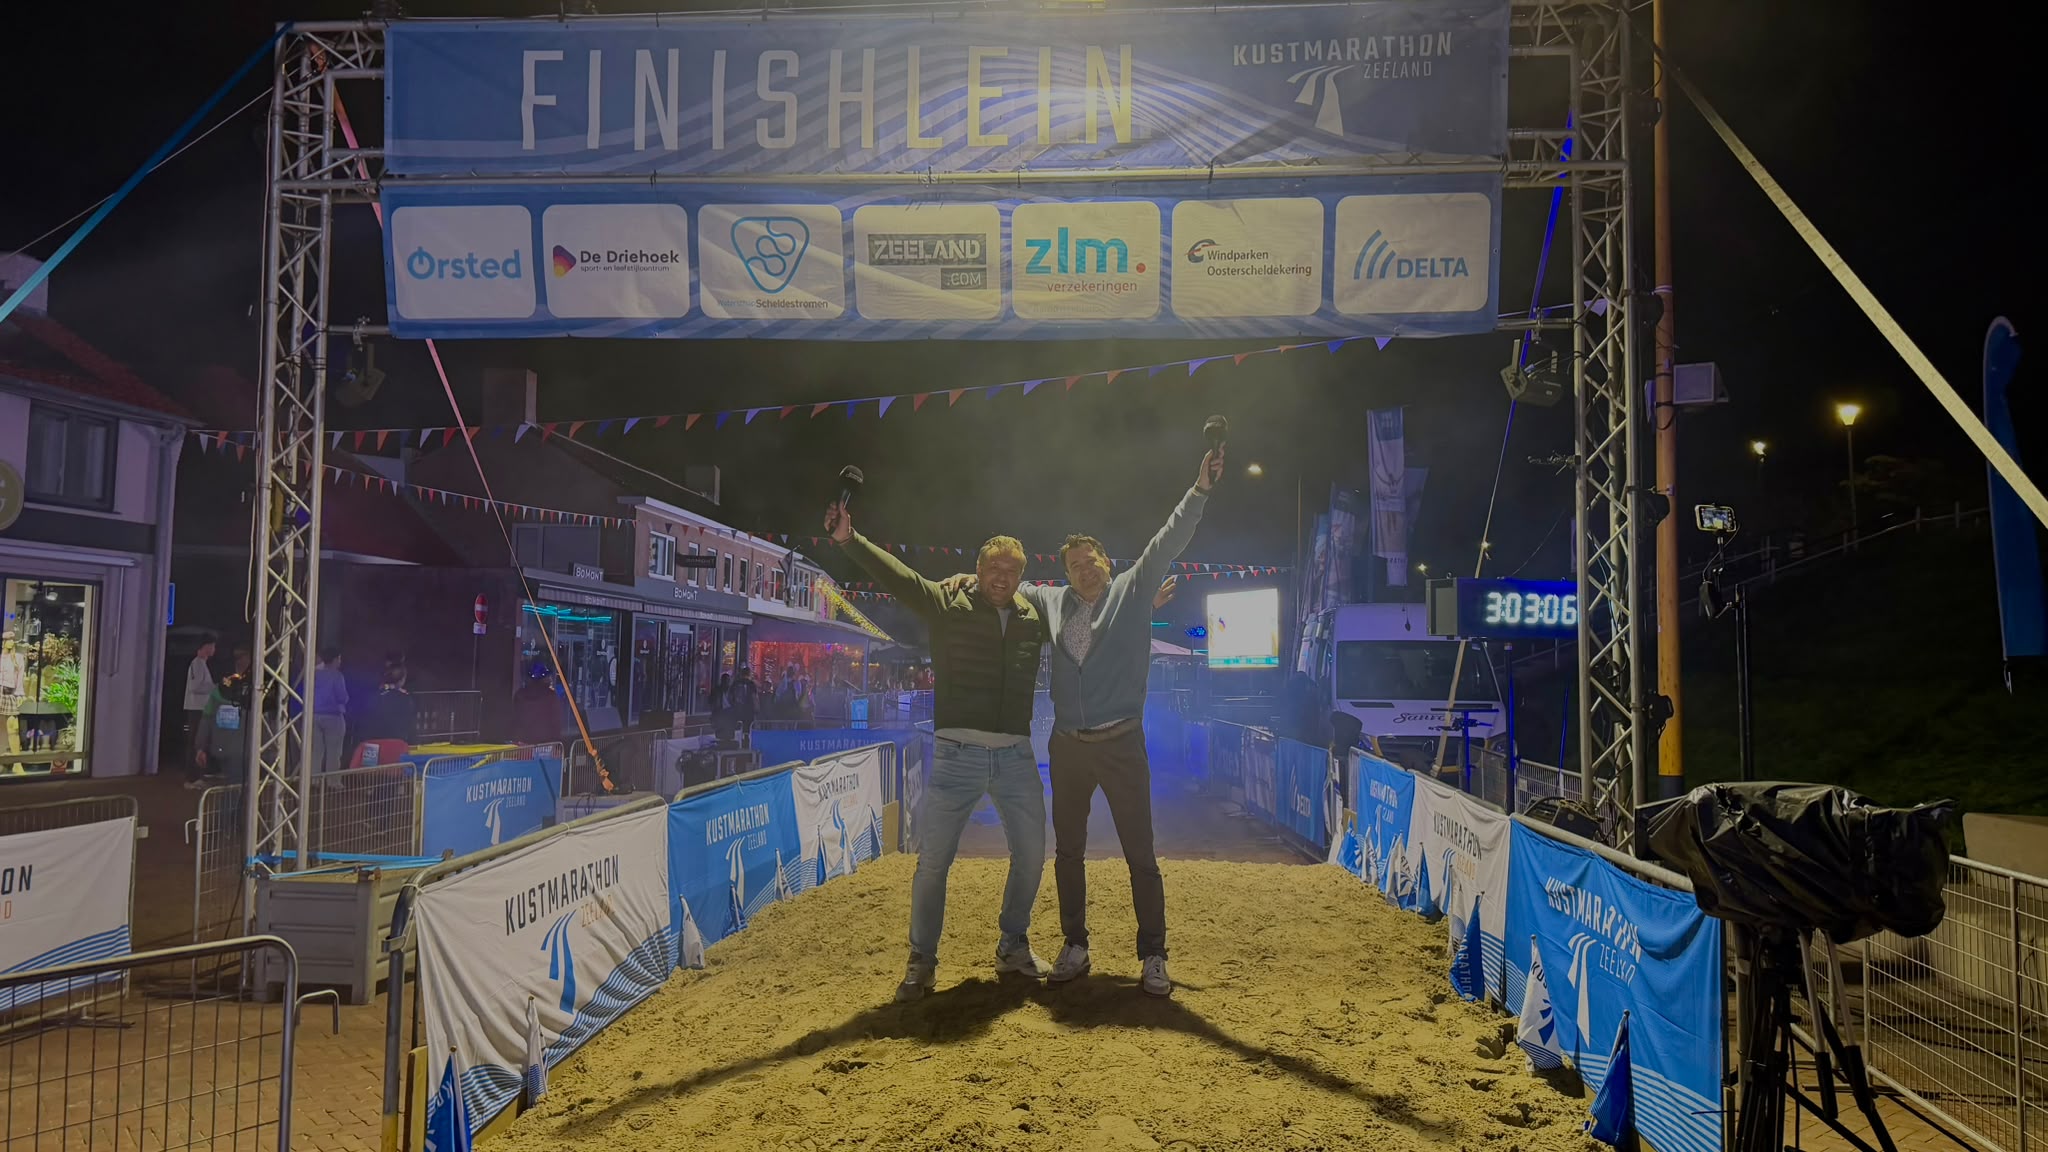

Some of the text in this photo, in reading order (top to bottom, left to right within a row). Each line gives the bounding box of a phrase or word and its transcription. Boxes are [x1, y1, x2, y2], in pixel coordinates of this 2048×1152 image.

[1232, 31, 1453, 66] KUSTMARATHON
[1363, 61, 1432, 79] ZEELAND
[580, 250, 680, 264] De Driehoek
[873, 239, 981, 261] ZEELAND
[1207, 249, 1269, 262] Windparken
[1207, 264, 1312, 278] Oosterscheldekering
[1396, 256, 1469, 279] DELTA
[1047, 281, 1138, 294] verzekeringen
[755, 299, 829, 309] Scheldestromen
[576, 567, 604, 581] BOMONT
[674, 587, 698, 600] BOMONT
[466, 776, 532, 803] KUSTMARATHON
[706, 802, 770, 846] KUSTMARATHON
[505, 854, 618, 936] KUSTMARATHON
